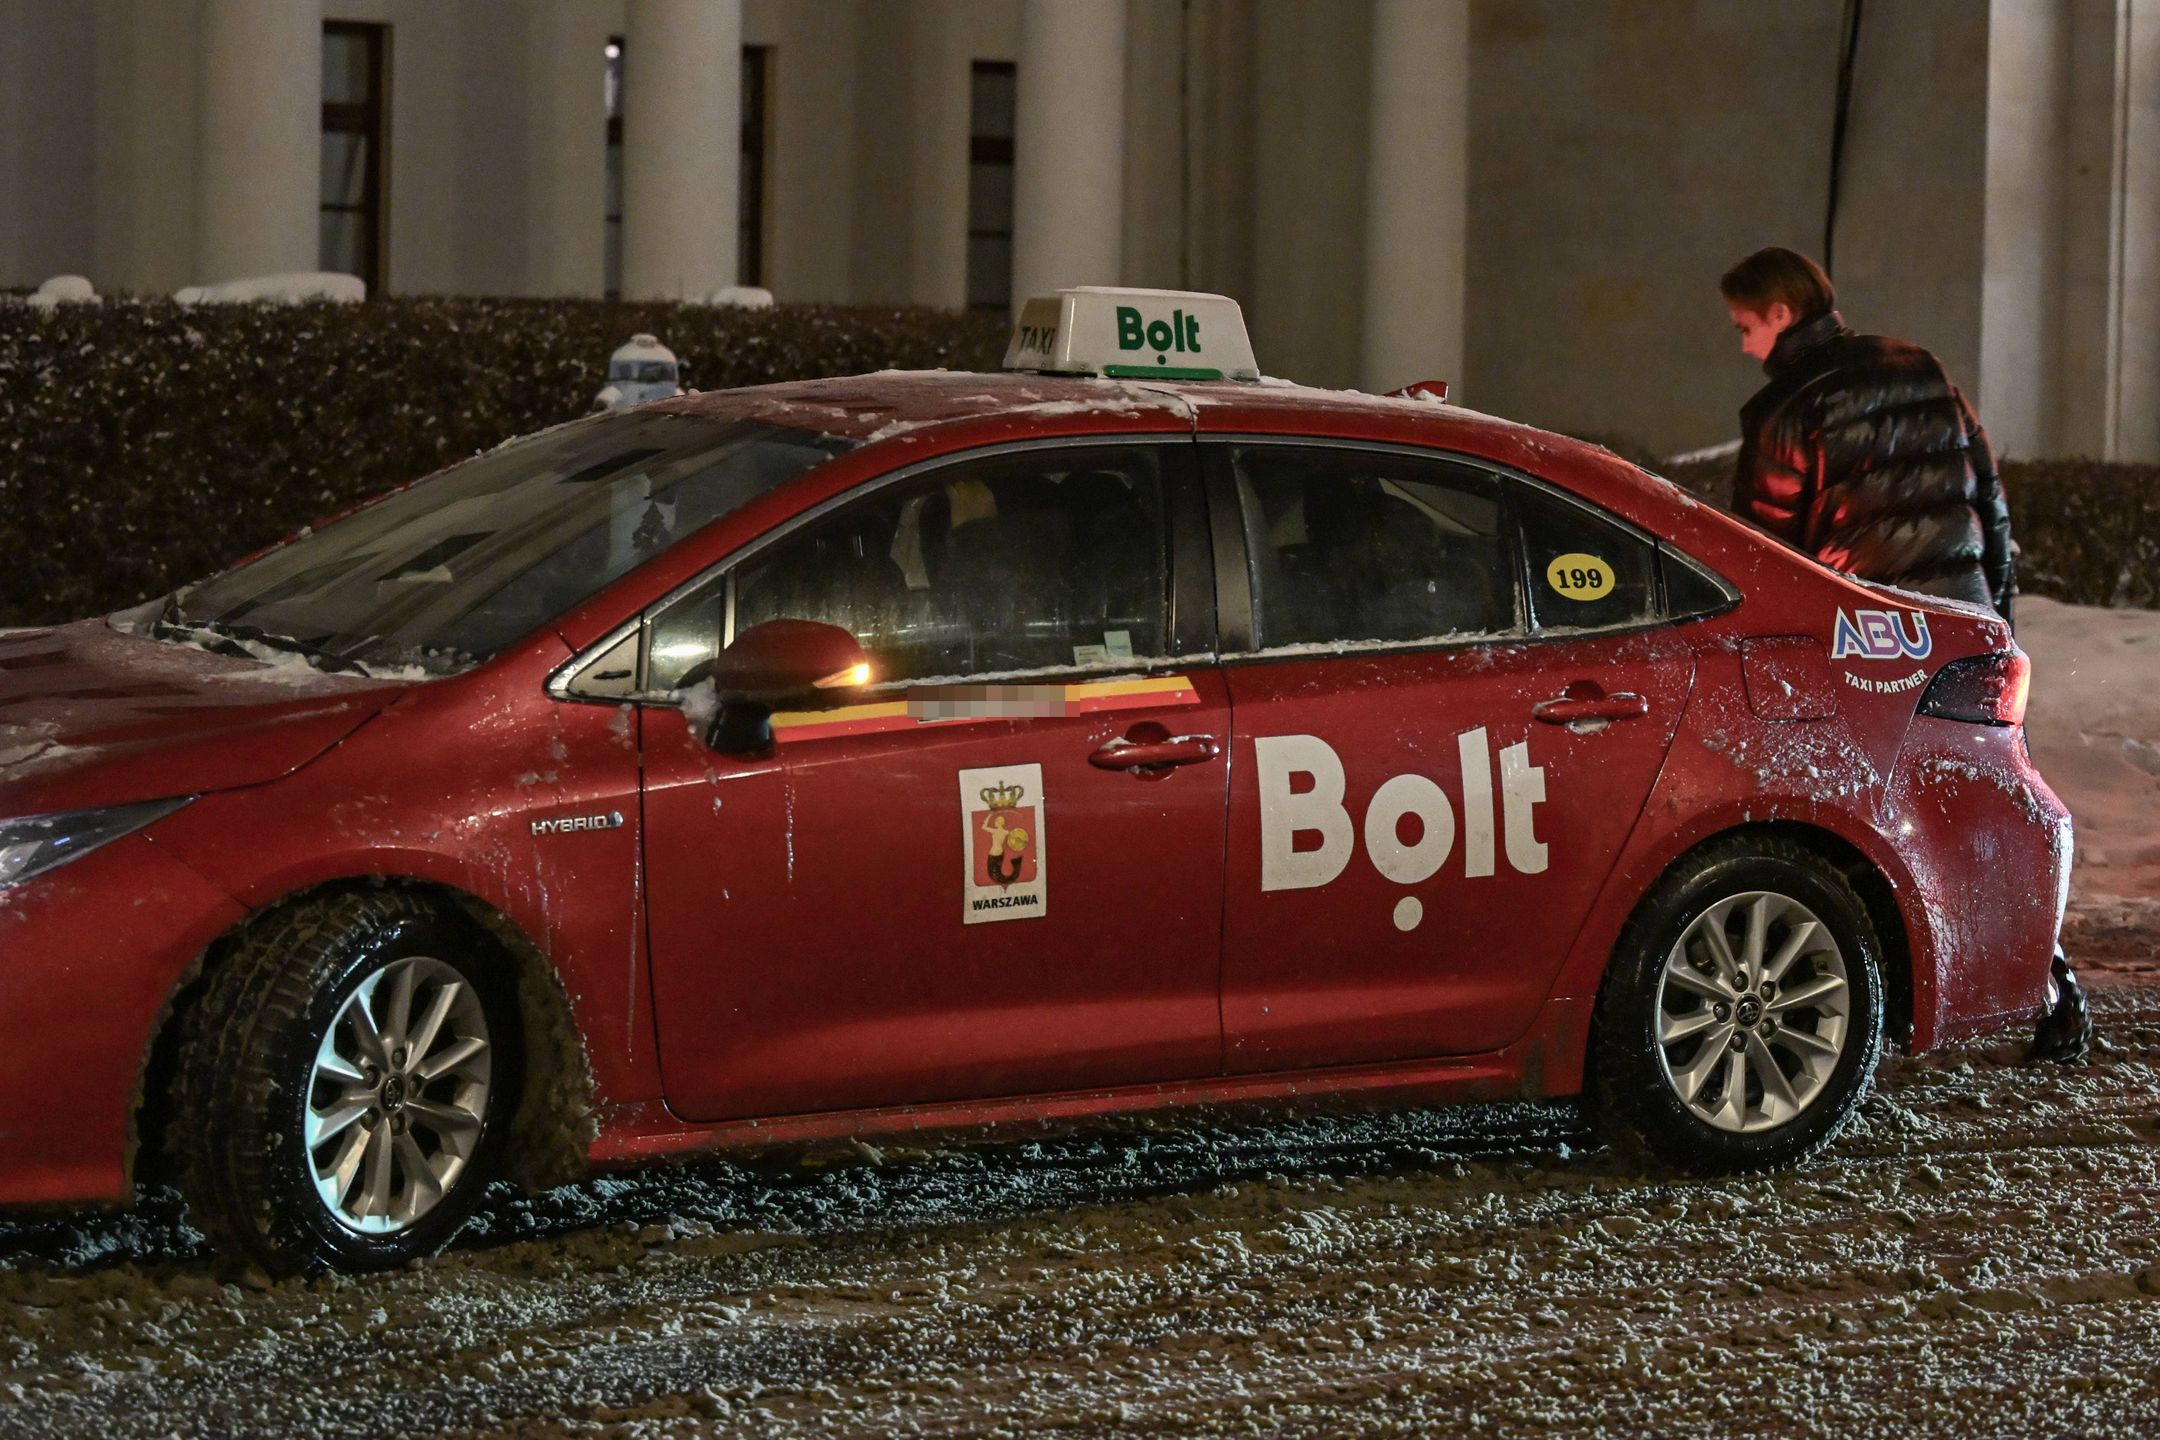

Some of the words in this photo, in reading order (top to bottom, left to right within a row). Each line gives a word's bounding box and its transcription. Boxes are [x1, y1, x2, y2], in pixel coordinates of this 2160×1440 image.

[1020, 326, 1056, 355] TAXI
[1116, 306, 1202, 365] Bolt
[1556, 568, 1603, 589] 199
[1831, 606, 1932, 660] ABU
[1844, 671, 1873, 692] TAXI
[1875, 669, 1928, 694] PARTNER
[531, 815, 608, 836] HYBRID
[1254, 726, 1549, 932] Bolt
[972, 894, 1039, 911] WARSZAWA
